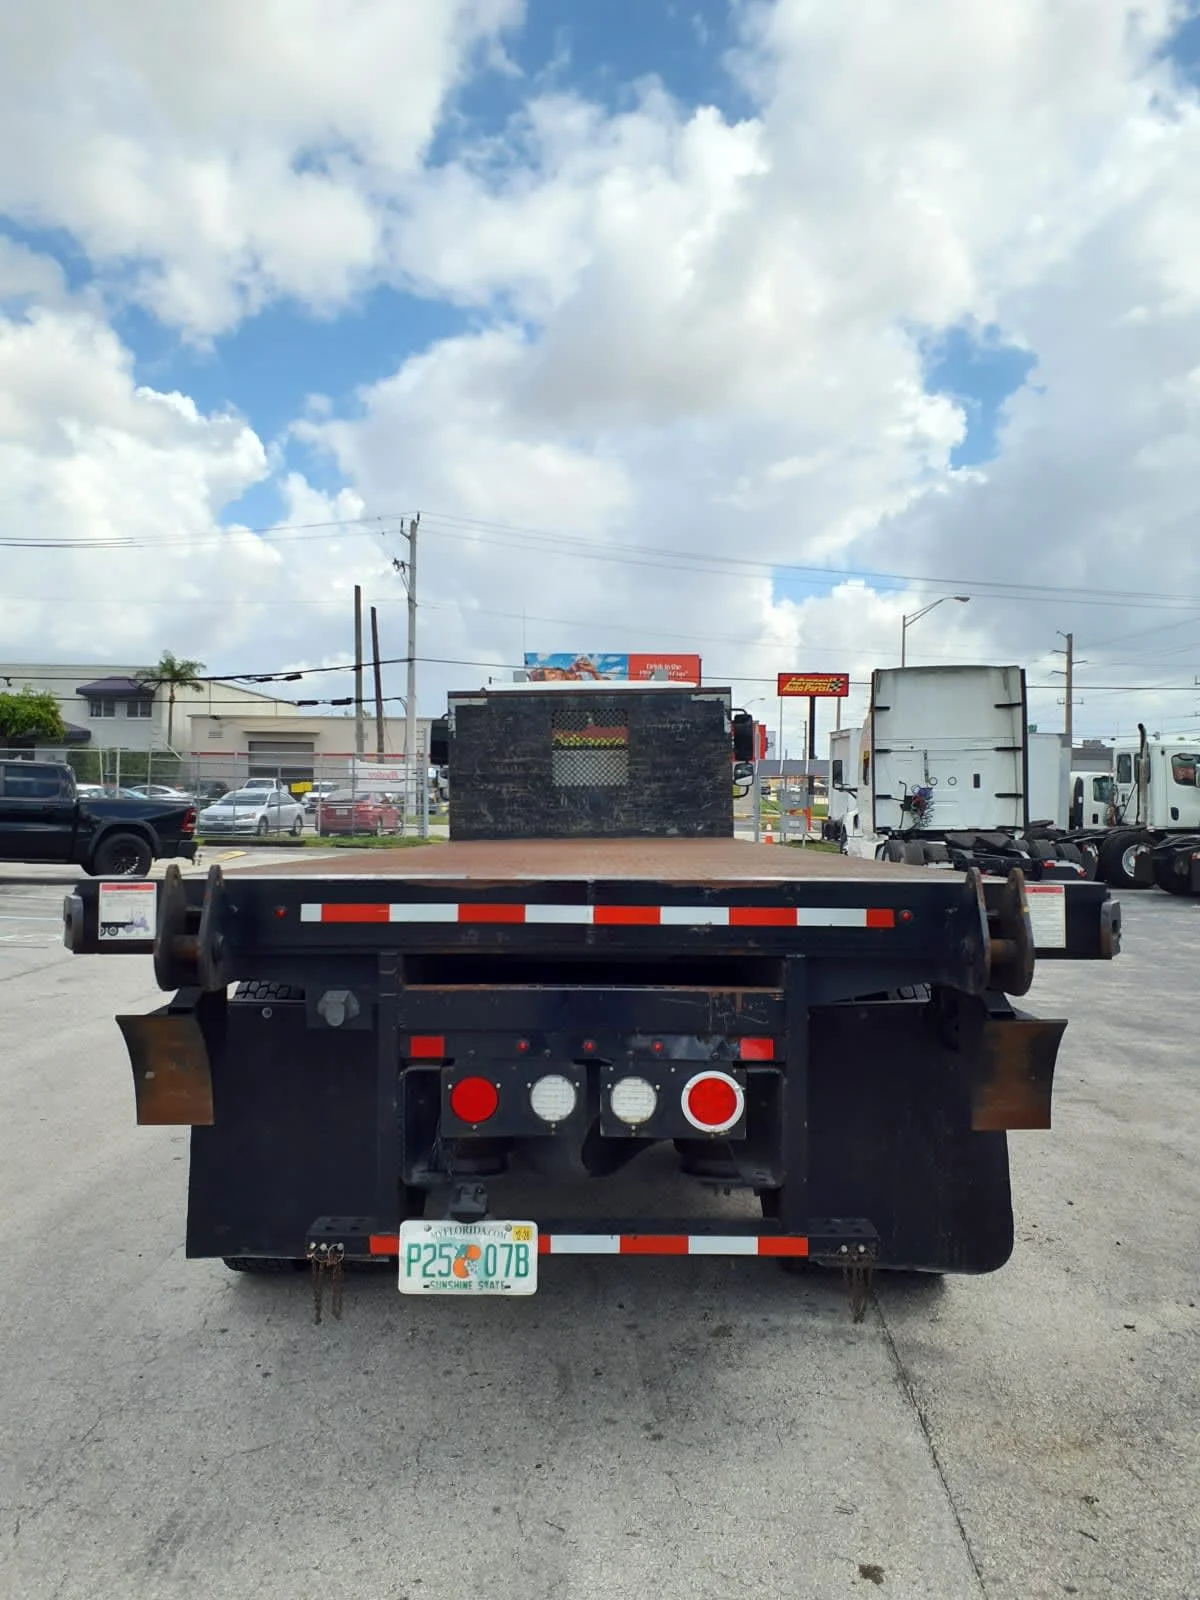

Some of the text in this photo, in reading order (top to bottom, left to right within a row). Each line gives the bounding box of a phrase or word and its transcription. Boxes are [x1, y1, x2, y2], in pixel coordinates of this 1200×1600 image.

[783, 684, 827, 692] Auto Parts
[406, 1243, 530, 1278] P25 07B
[429, 1280, 505, 1290] SUNSHINE STATE
